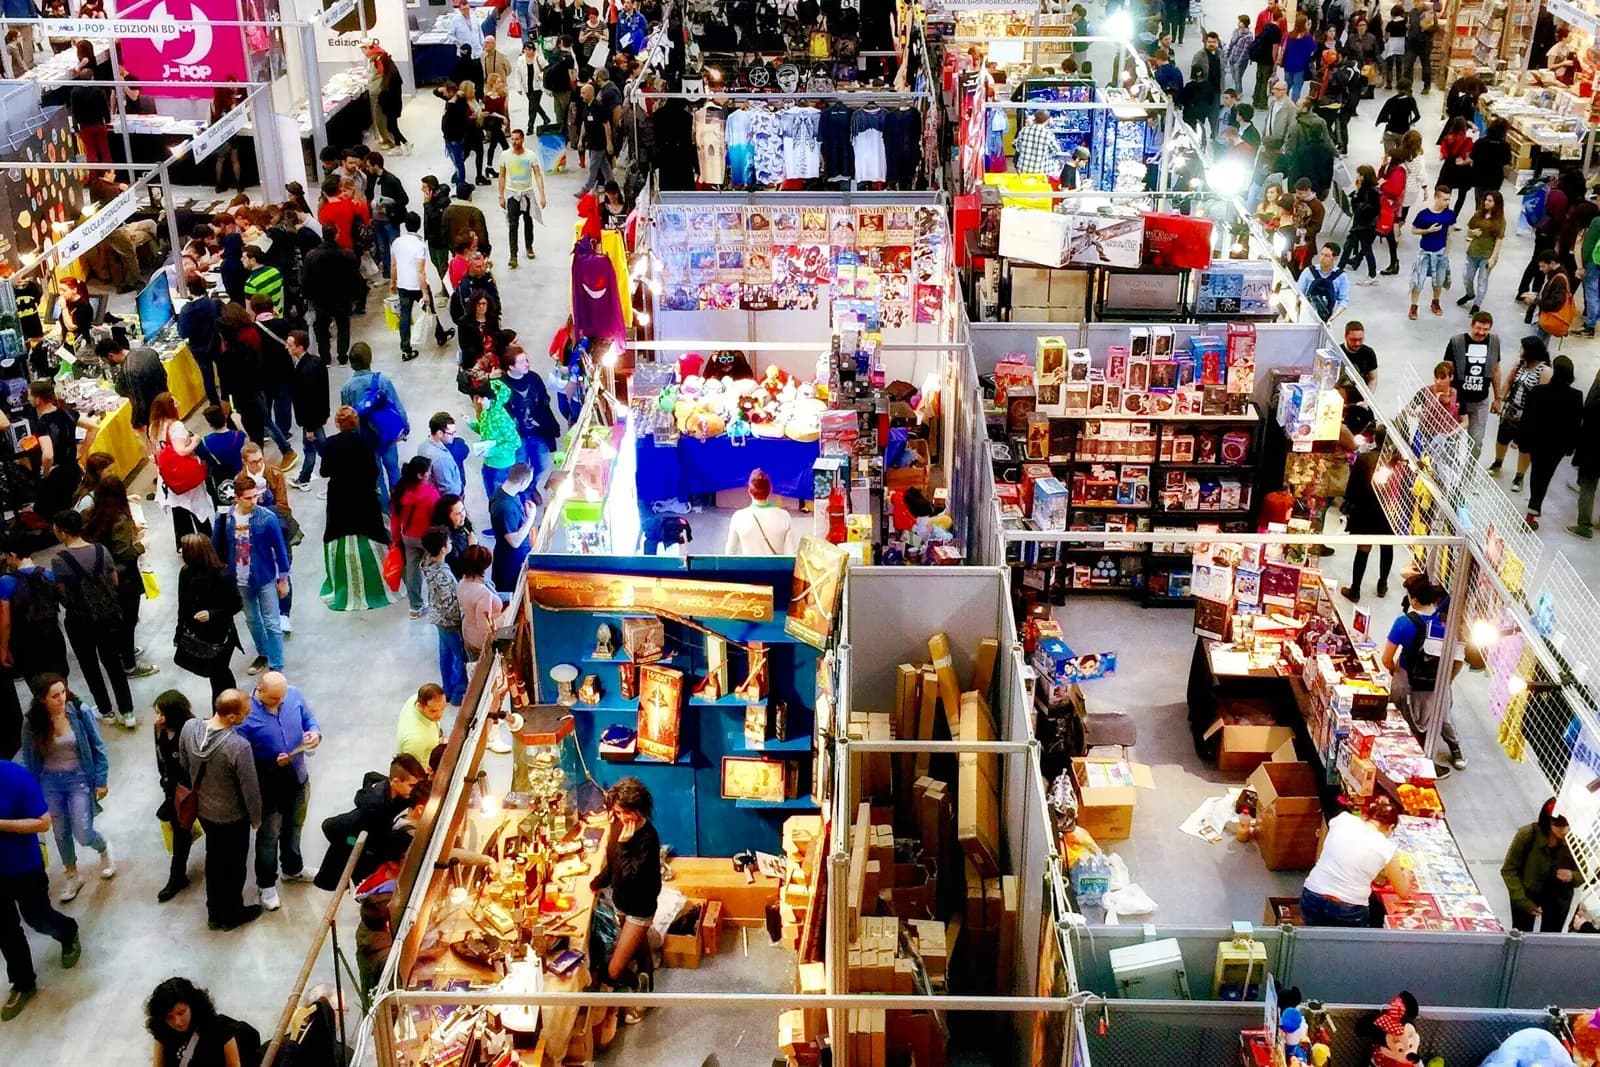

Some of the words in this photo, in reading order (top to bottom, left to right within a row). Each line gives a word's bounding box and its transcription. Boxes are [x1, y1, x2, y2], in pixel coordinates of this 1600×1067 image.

[77, 24, 105, 32] J-POP
[113, 24, 159, 33] EDIZIONI
[161, 25, 175, 34] BD
[162, 64, 212, 79] J-POP
[1465, 375, 1484, 384] LET'S
[1462, 383, 1484, 391] COOK
